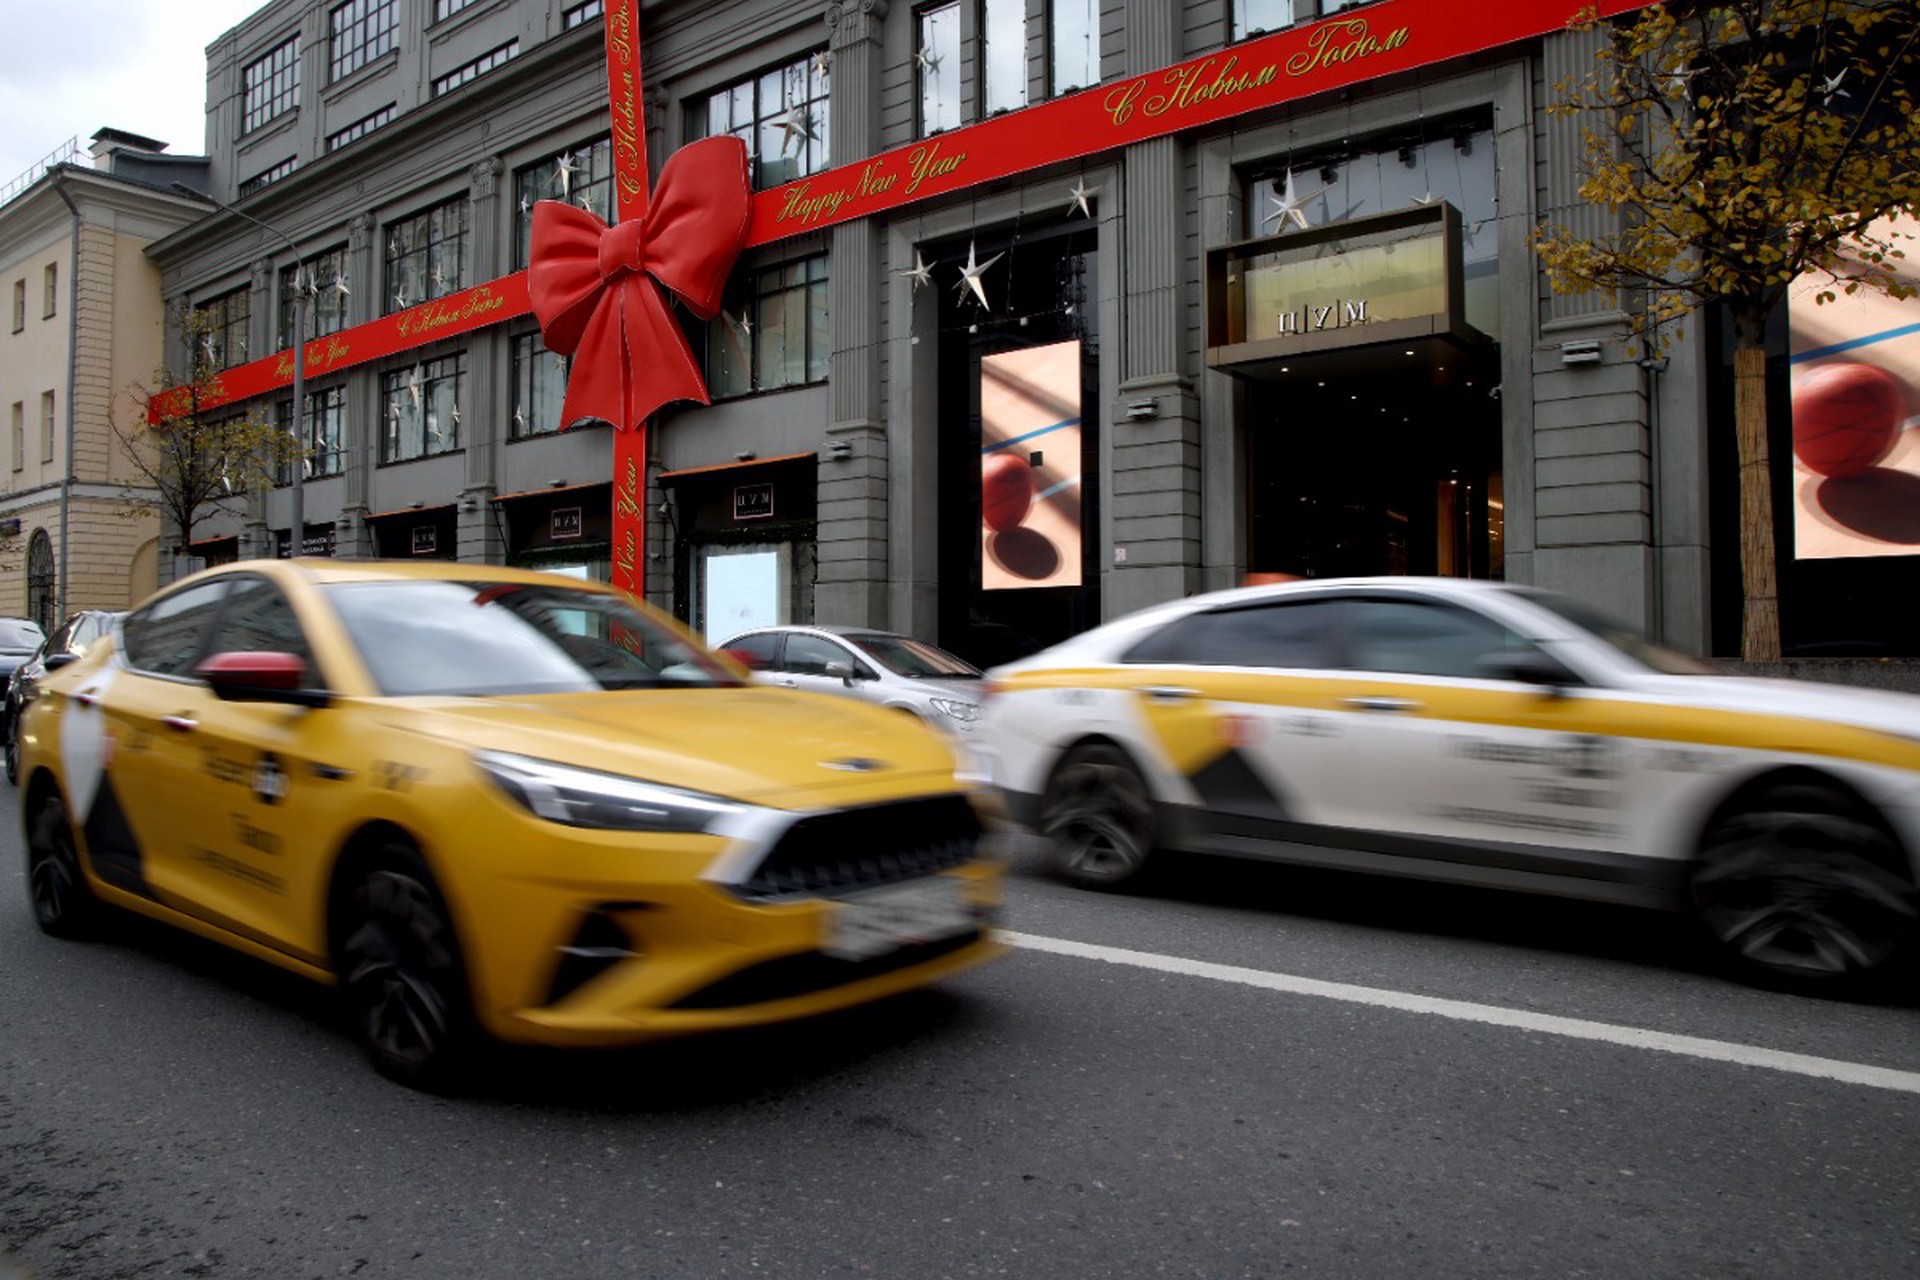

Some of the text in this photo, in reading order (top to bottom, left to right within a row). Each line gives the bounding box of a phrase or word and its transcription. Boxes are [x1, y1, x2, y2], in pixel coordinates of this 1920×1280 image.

[609, 0, 632, 65] Годо
[1143, 56, 1278, 117] Новым
[1285, 18, 1410, 77] Годом
[776, 141, 967, 226] Happy New Year
[616, 456, 642, 521] Year
[616, 531, 636, 589] New
